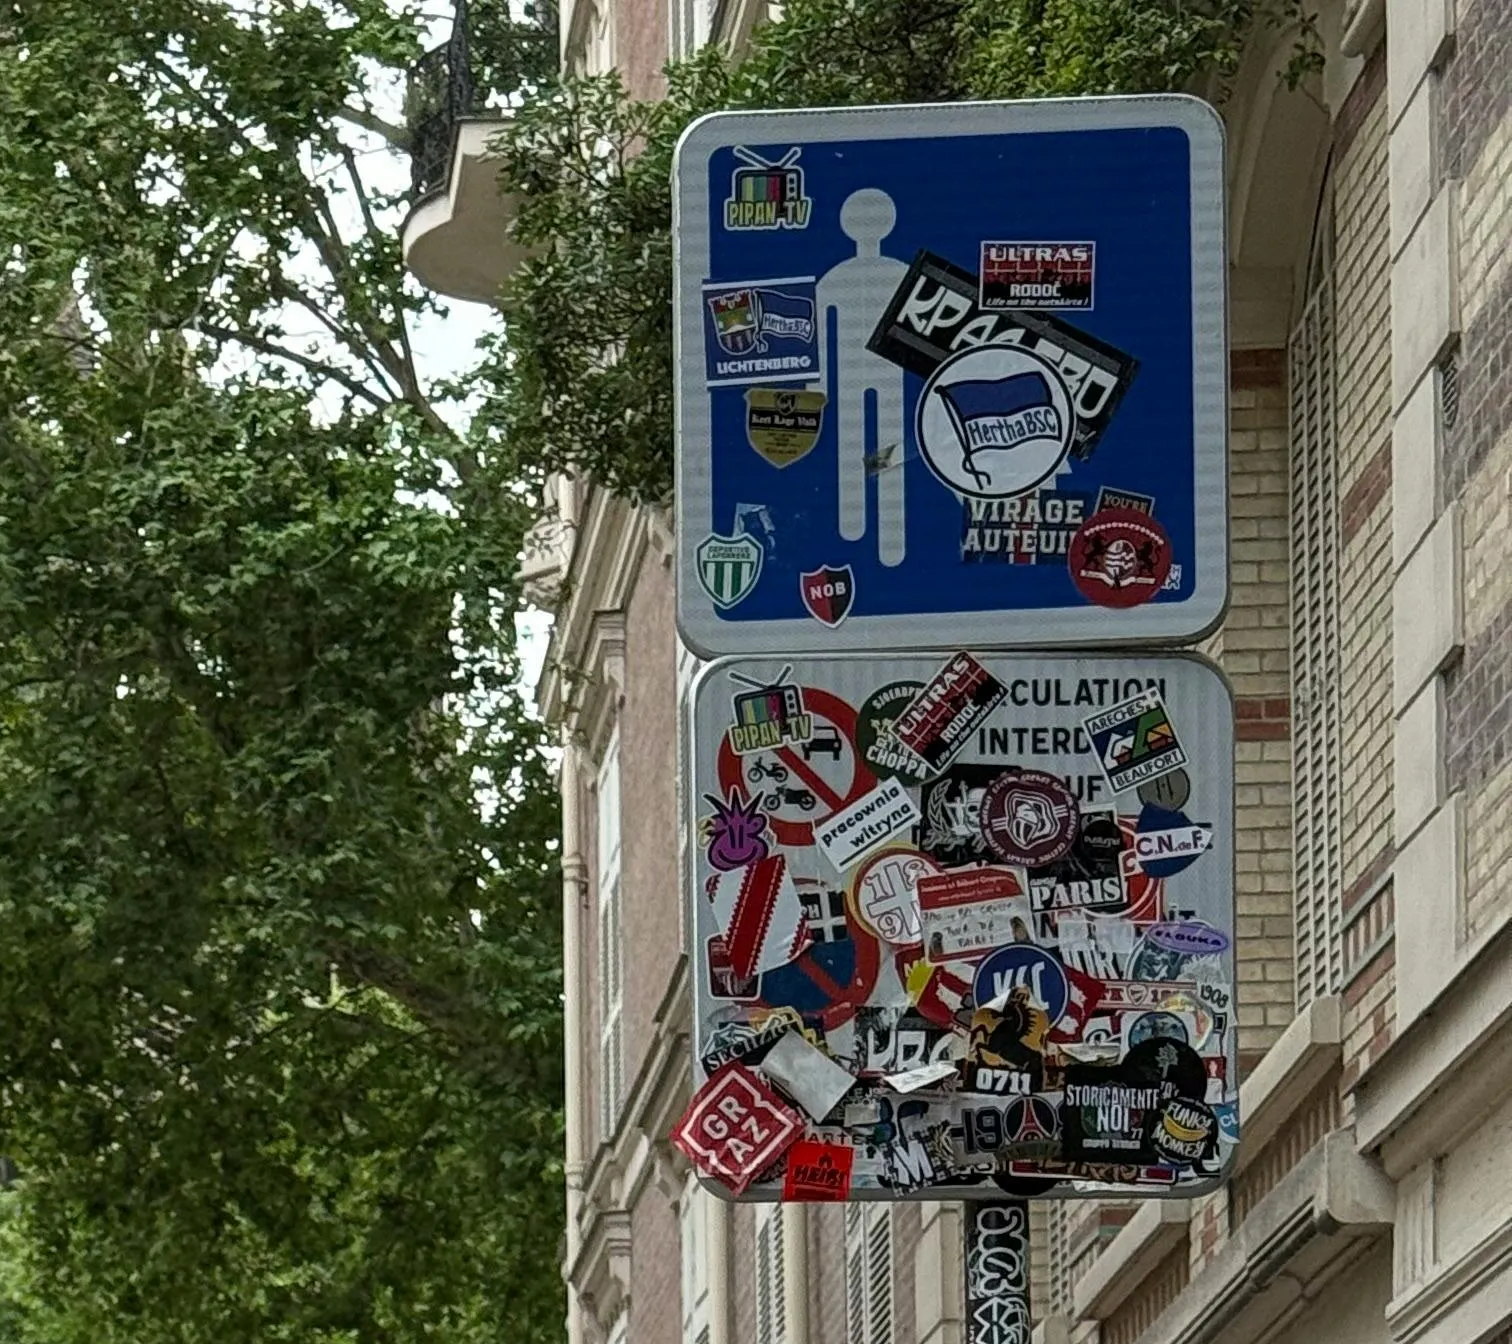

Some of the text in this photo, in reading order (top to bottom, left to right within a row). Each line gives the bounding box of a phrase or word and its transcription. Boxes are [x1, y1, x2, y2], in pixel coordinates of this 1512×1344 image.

[729, 200, 807, 225] PIPAN TV
[989, 247, 1088, 262] ULTRAS
[716, 355, 812, 375] LICHTENBERG
[968, 498, 1085, 524] VIRAGE
[962, 528, 1071, 555] AUTEUI
[810, 581, 846, 600] NOB
[898, 656, 971, 736] ULTRAS
[1008, 677, 1167, 706] CULATION
[732, 714, 812, 751] PIPAN TV
[978, 727, 1092, 755] INTERD
[865, 744, 929, 780] CHOPPA
[1115, 749, 1179, 787] BEAUFORT
[1066, 775, 1105, 802] UF
[821, 785, 900, 848] pracownia
[1031, 877, 1121, 910] PARIS
[1199, 984, 1230, 1008] 1908
[976, 1067, 1032, 1095] 0711
[1066, 1084, 1160, 1110] STORICAMENTE
[702, 1095, 748, 1140] GR
[1096, 1104, 1130, 1133] NOI
[1167, 1101, 1214, 1129] FUNKY
[1150, 1121, 1206, 1158] MONKEY
